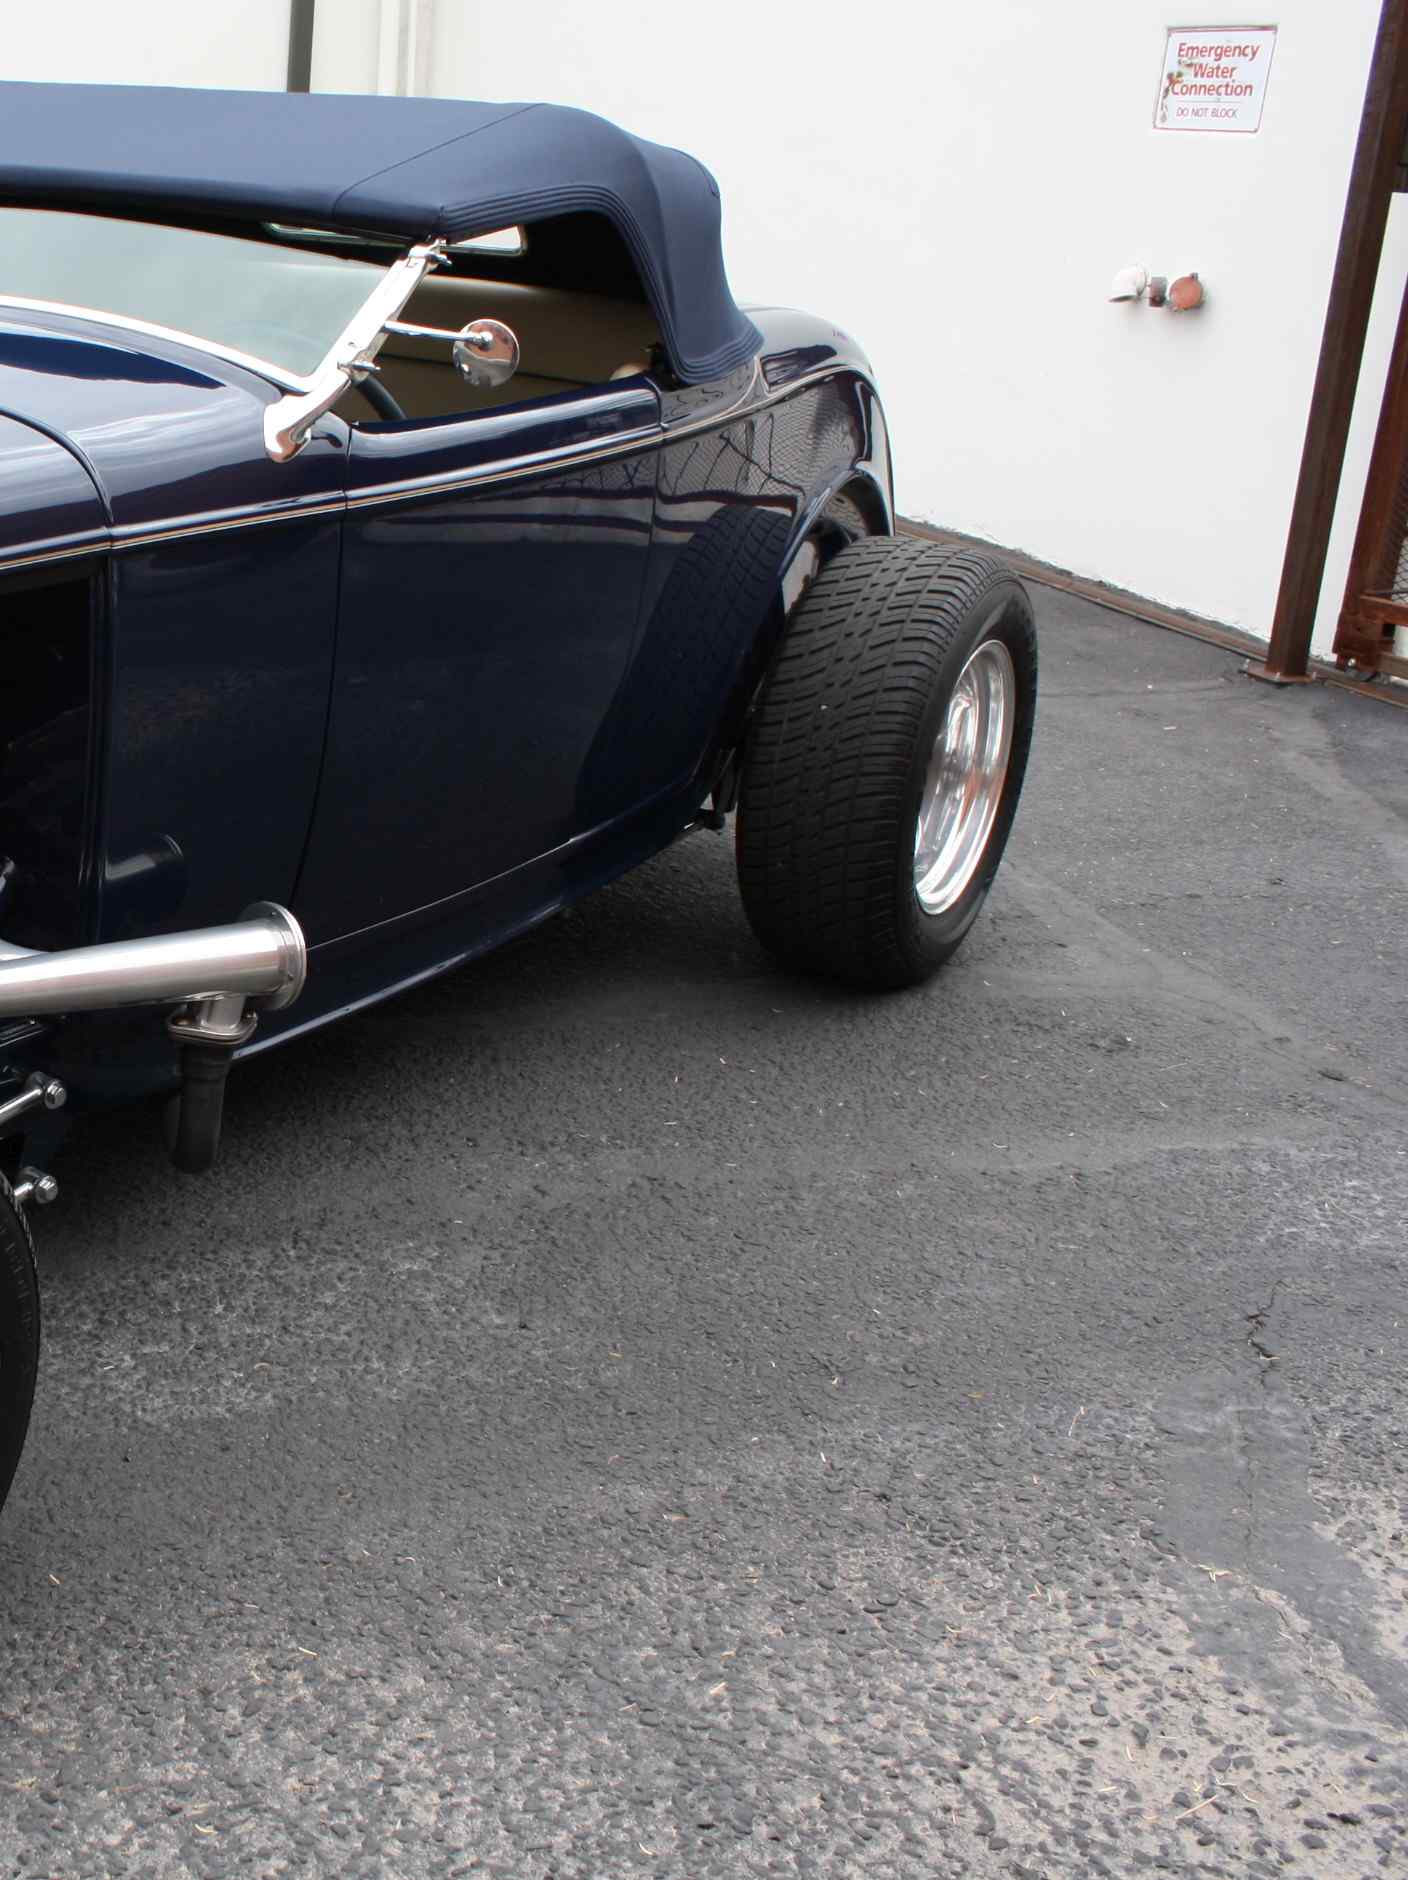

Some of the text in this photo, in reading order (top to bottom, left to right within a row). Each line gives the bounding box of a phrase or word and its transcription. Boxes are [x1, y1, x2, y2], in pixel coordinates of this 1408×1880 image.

[1177, 42, 1261, 62] Emergency
[1192, 62, 1238, 79] Water
[1170, 81, 1254, 97] Connection
[1176, 106, 1238, 119] DO NOT BLOCK
